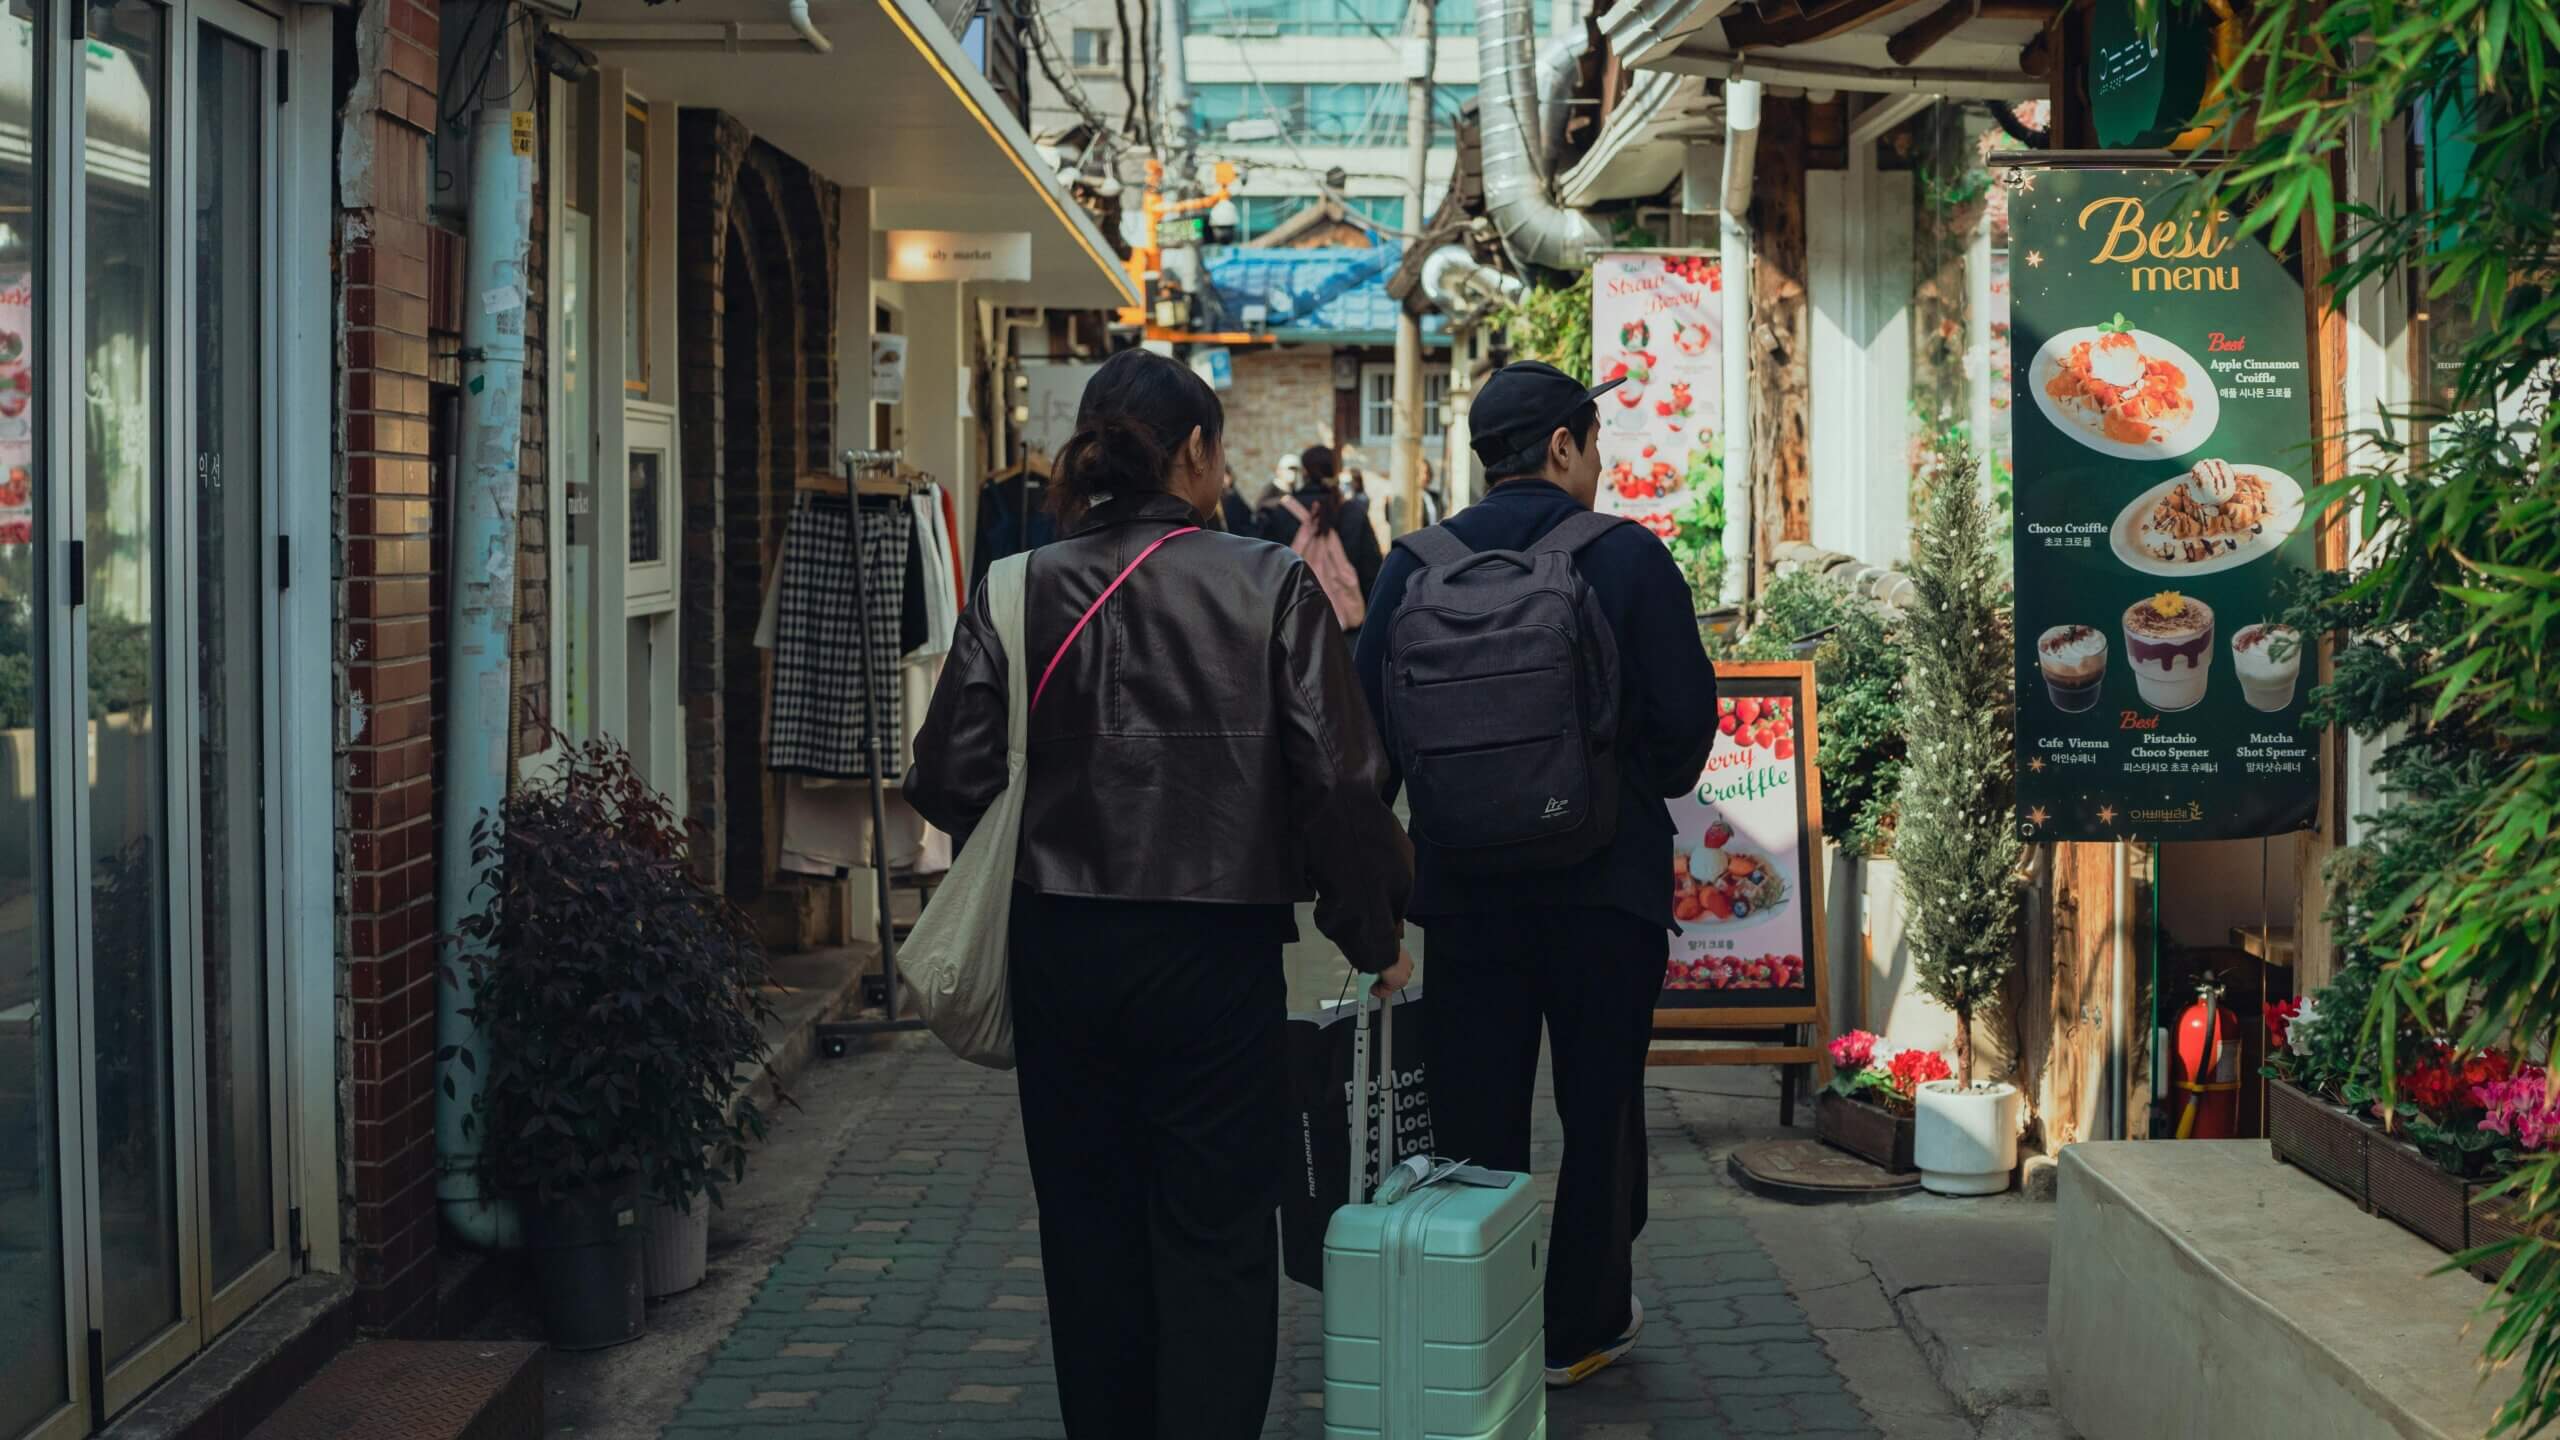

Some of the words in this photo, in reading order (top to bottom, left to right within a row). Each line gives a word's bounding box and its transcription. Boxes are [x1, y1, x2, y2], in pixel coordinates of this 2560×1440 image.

[2078, 196, 2230, 265] Best
[953, 249, 992, 261] market
[2131, 266, 2240, 292] menu
[2207, 331, 2246, 352] Best
[2210, 359, 2242, 372] Apple
[2243, 359, 2300, 369] Cinnamon
[2235, 372, 2276, 383] Croiffle
[2219, 388, 2237, 399] 애플
[2239, 388, 2265, 399] 시나몬
[2266, 388, 2292, 399] 크로플
[199, 452, 221, 489] 익선
[2027, 522, 2063, 534] Choco
[2064, 522, 2108, 534] Croiffle
[2044, 537, 2063, 547] 초코
[2064, 537, 2092, 547] 크로플
[2119, 711, 2160, 729] Best
[2037, 737, 2064, 748] Cafe
[2068, 737, 2110, 748] Vienna
[2143, 733, 2197, 744] Pistachio
[2250, 733, 2294, 744] Matcha
[1708, 748, 1756, 771] erry
[2051, 753, 2097, 764] 아인슈페너
[2131, 747, 2166, 758] Choco
[2168, 747, 2210, 760] Spener
[2236, 747, 2264, 758] Shot
[2265, 747, 2307, 760] Spener
[2123, 762, 2169, 773] 피스타치오
[2170, 762, 2189, 772] 초코
[2191, 762, 2218, 773] 슈페너
[1696, 765, 1791, 805] Croiffle
